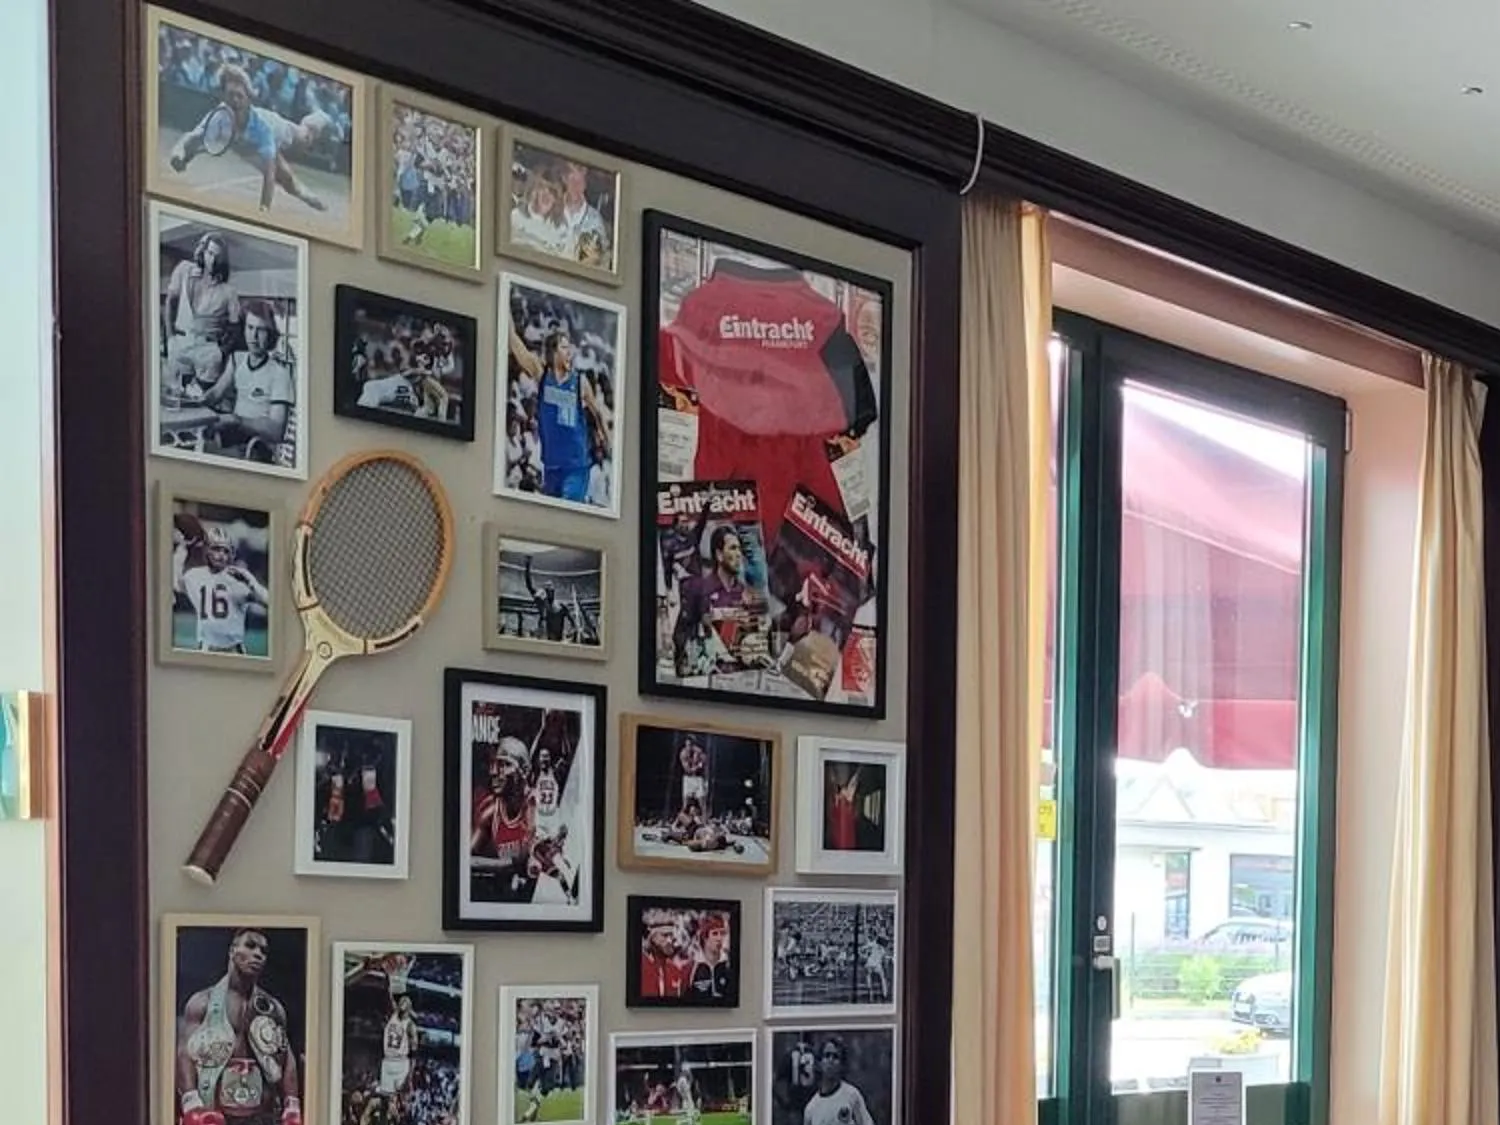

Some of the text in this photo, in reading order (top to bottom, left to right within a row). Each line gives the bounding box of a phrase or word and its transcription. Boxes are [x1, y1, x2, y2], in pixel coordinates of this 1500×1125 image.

[720, 314, 815, 341] Eintracht
[656, 483, 756, 515] Eintracht
[791, 492, 869, 572] Eintracht
[199, 583, 229, 620] 16
[791, 1050, 815, 1087] 13
